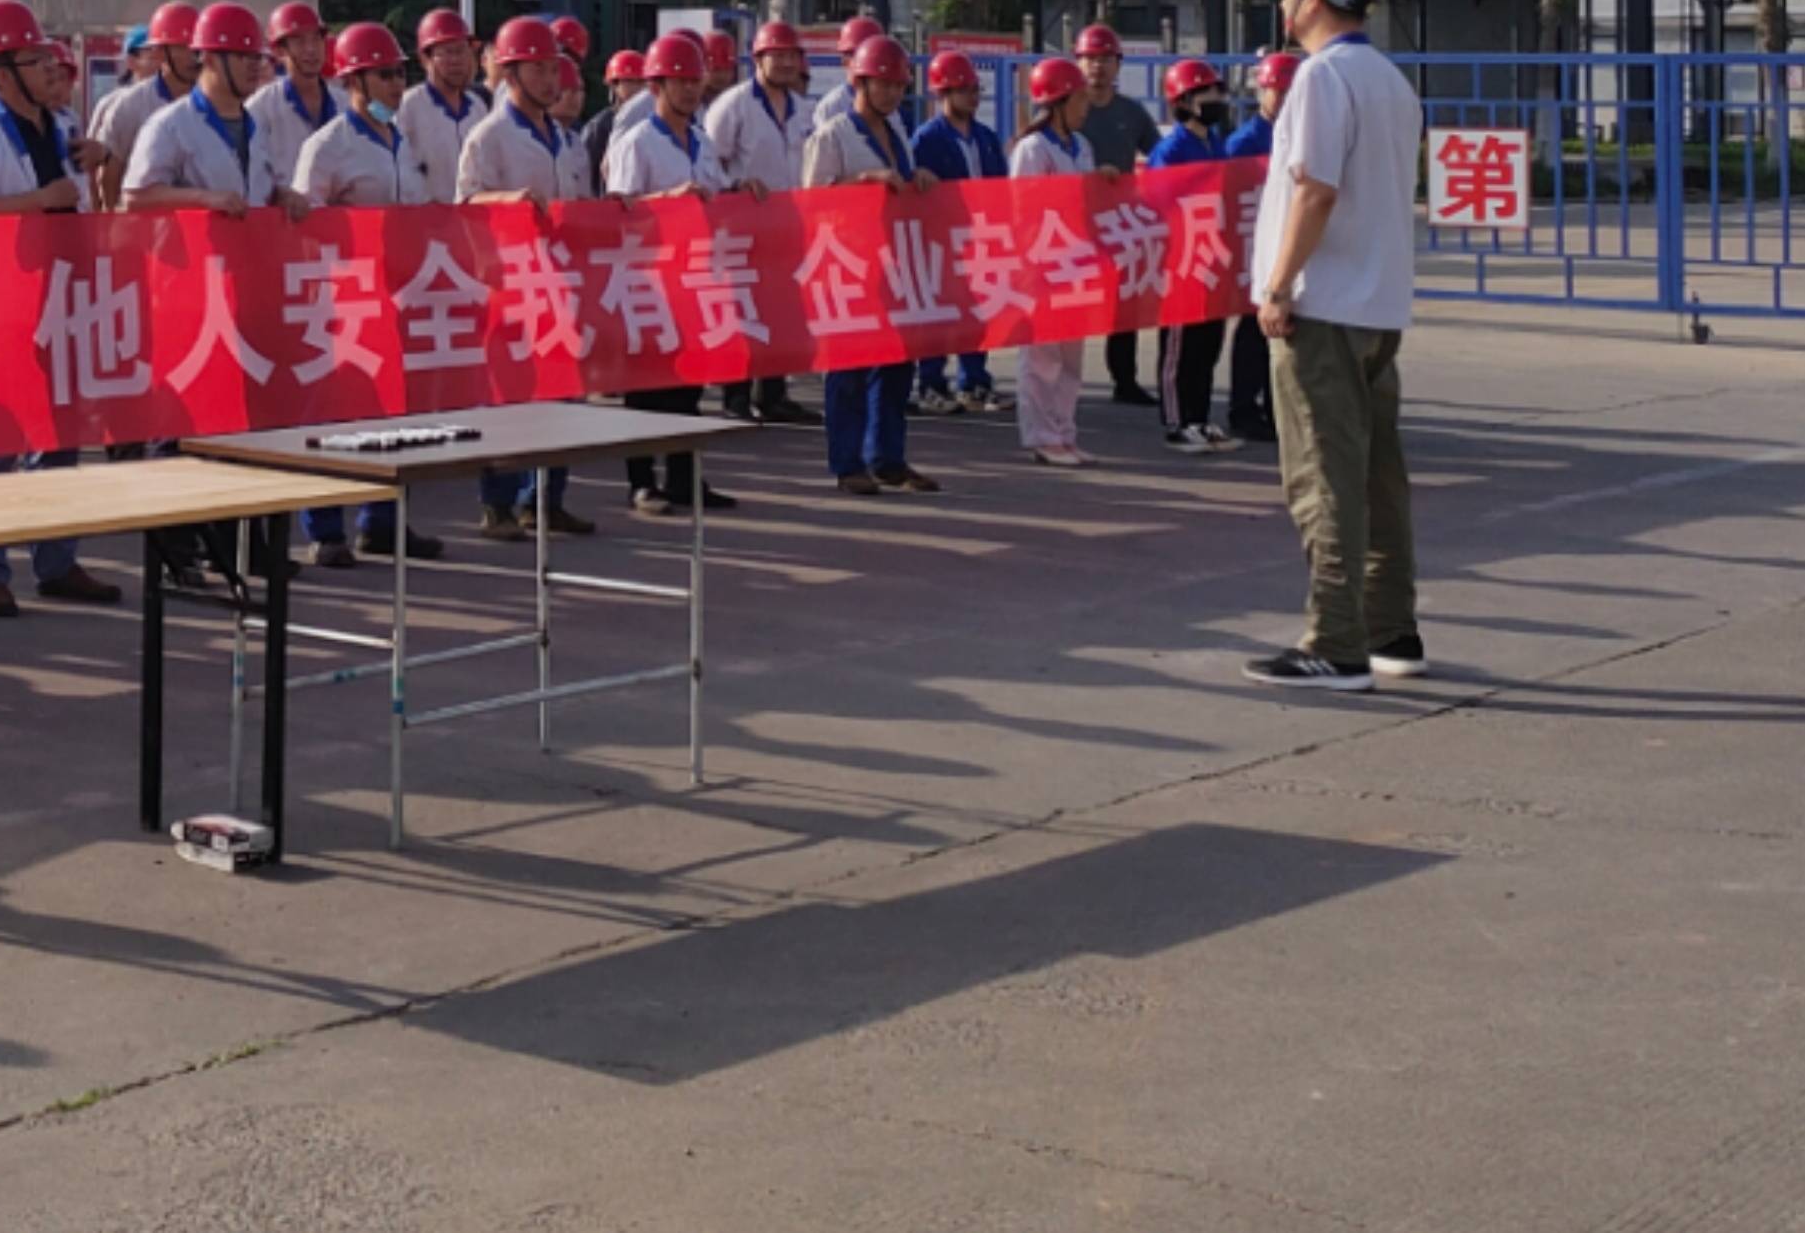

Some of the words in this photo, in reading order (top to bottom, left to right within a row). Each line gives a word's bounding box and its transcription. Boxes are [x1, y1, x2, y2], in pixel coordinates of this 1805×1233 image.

[1437, 134, 1521, 222] 第
[34, 228, 770, 407] 他人安全我有责
